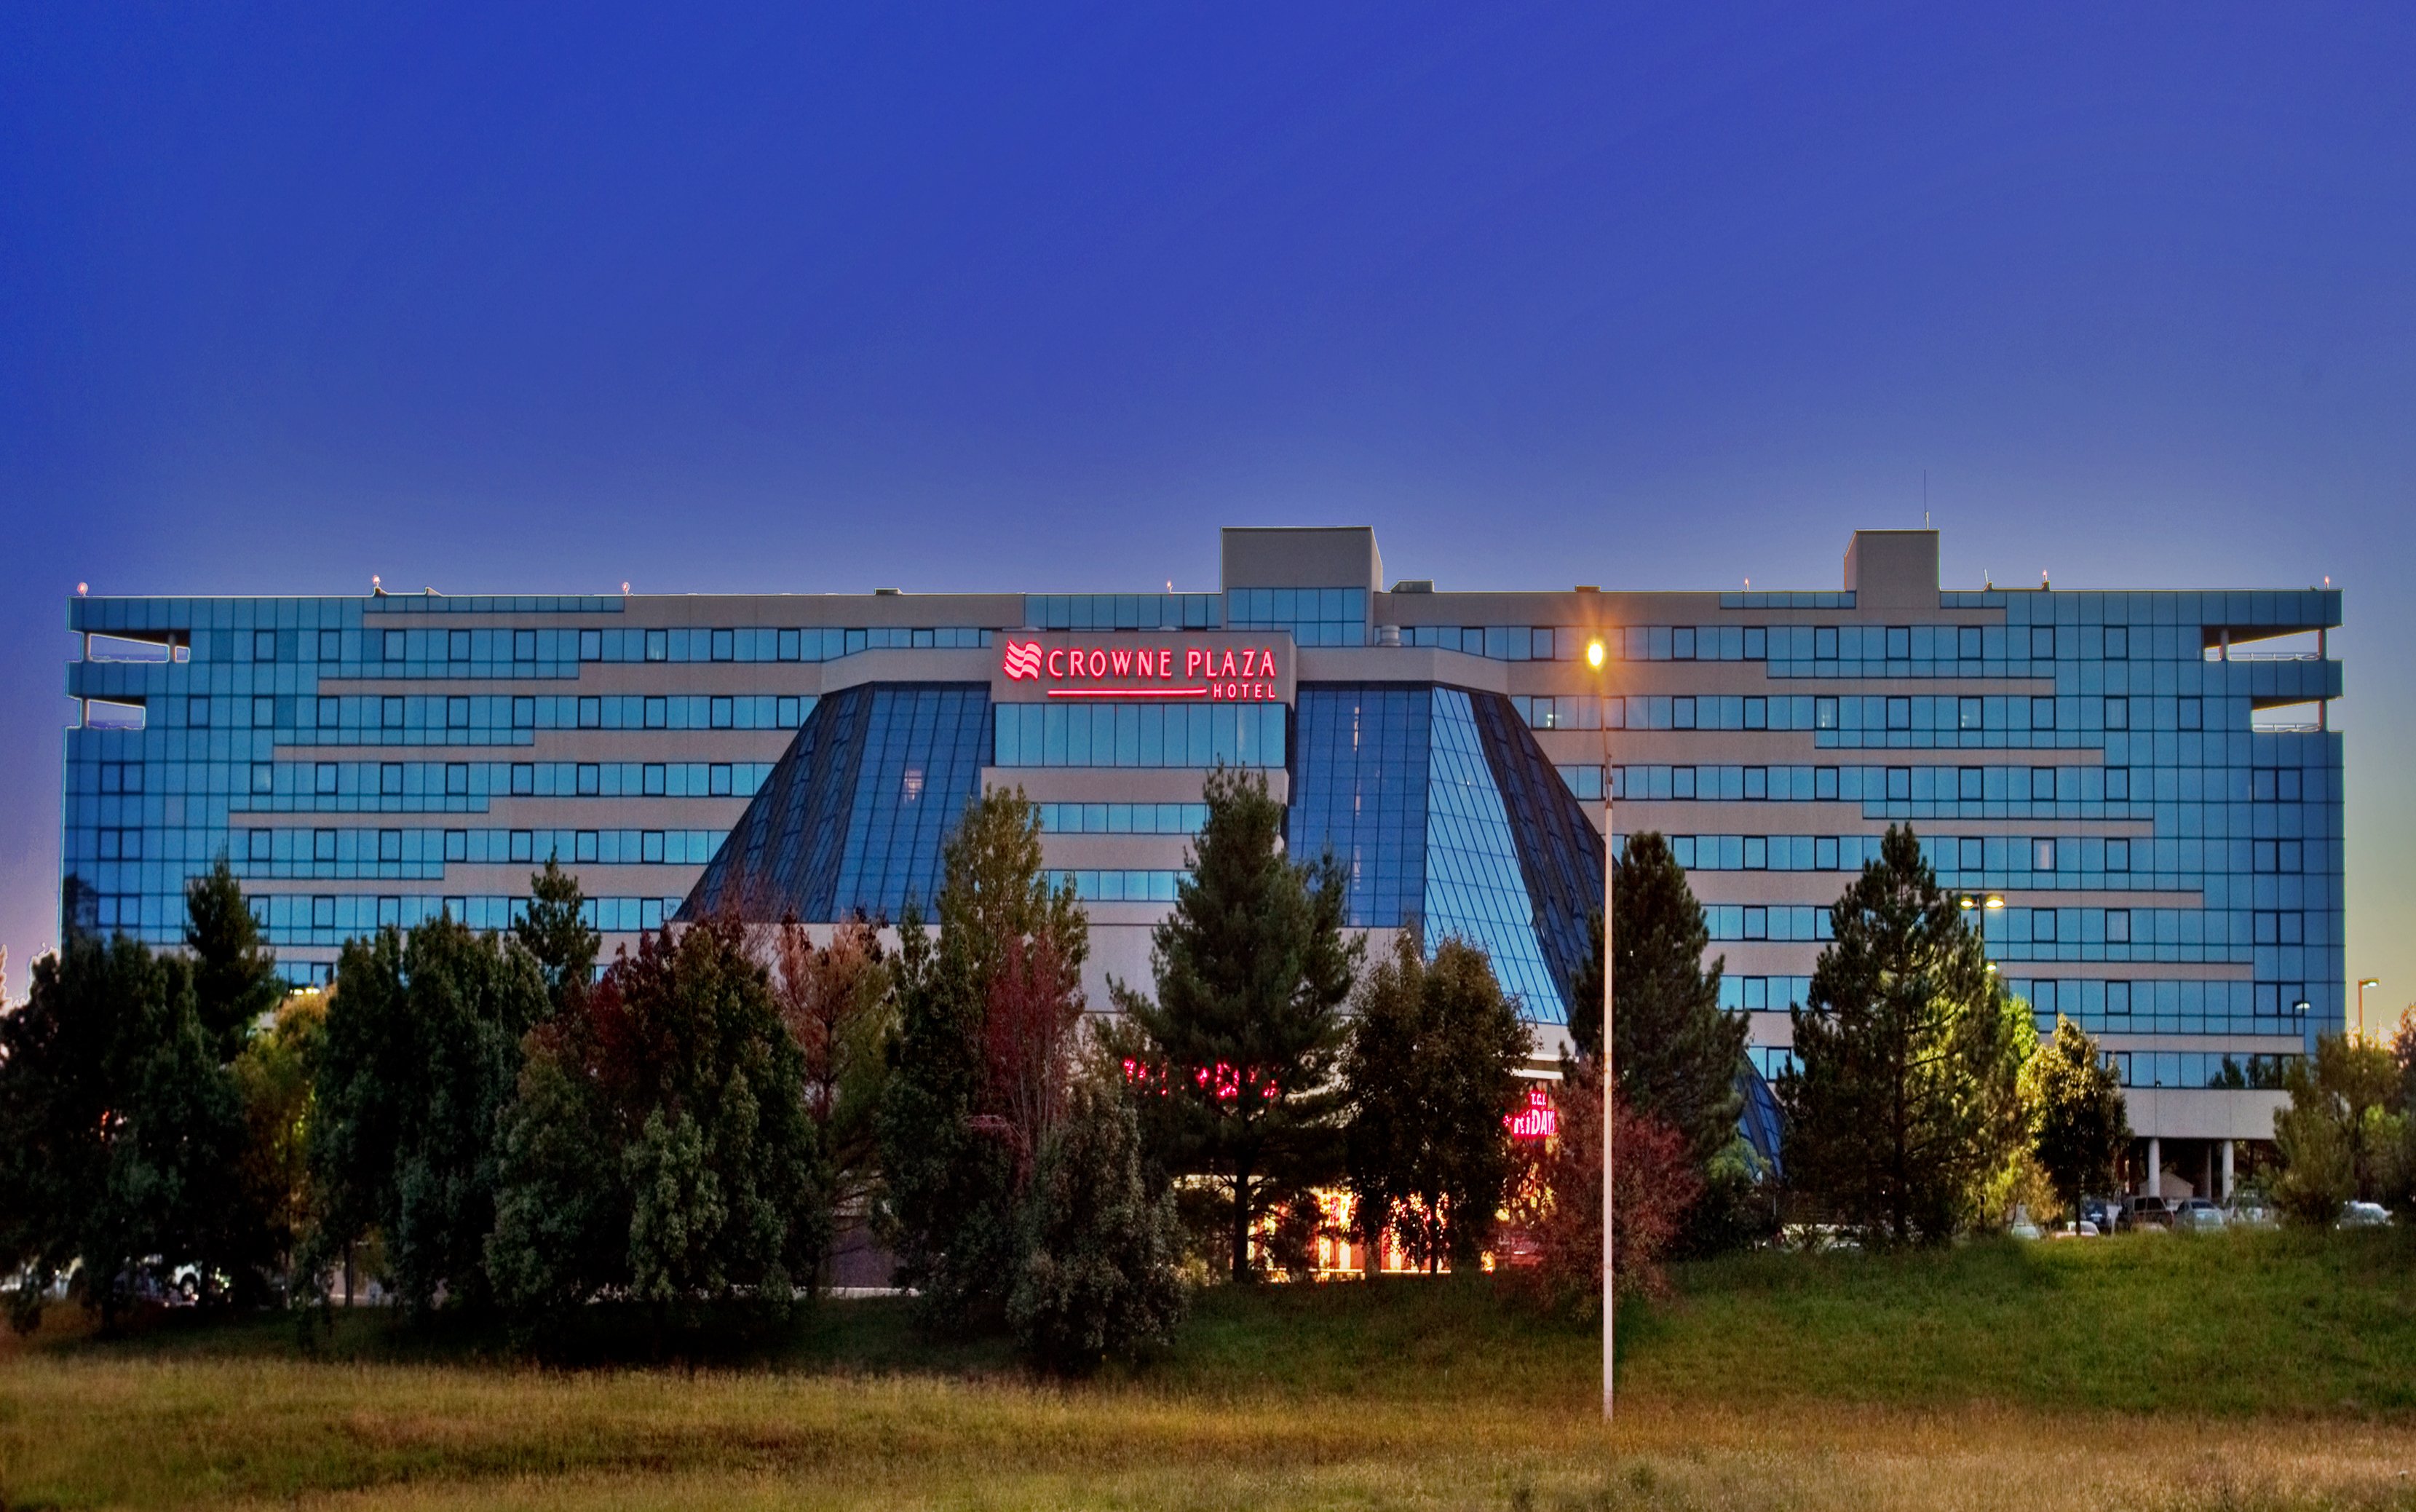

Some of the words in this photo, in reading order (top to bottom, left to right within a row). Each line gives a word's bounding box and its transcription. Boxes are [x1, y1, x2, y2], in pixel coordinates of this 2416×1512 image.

[1047, 649, 1173, 678] CROWNE
[1187, 649, 1276, 678] PLAZA
[1212, 683, 1277, 699] HOTEL
